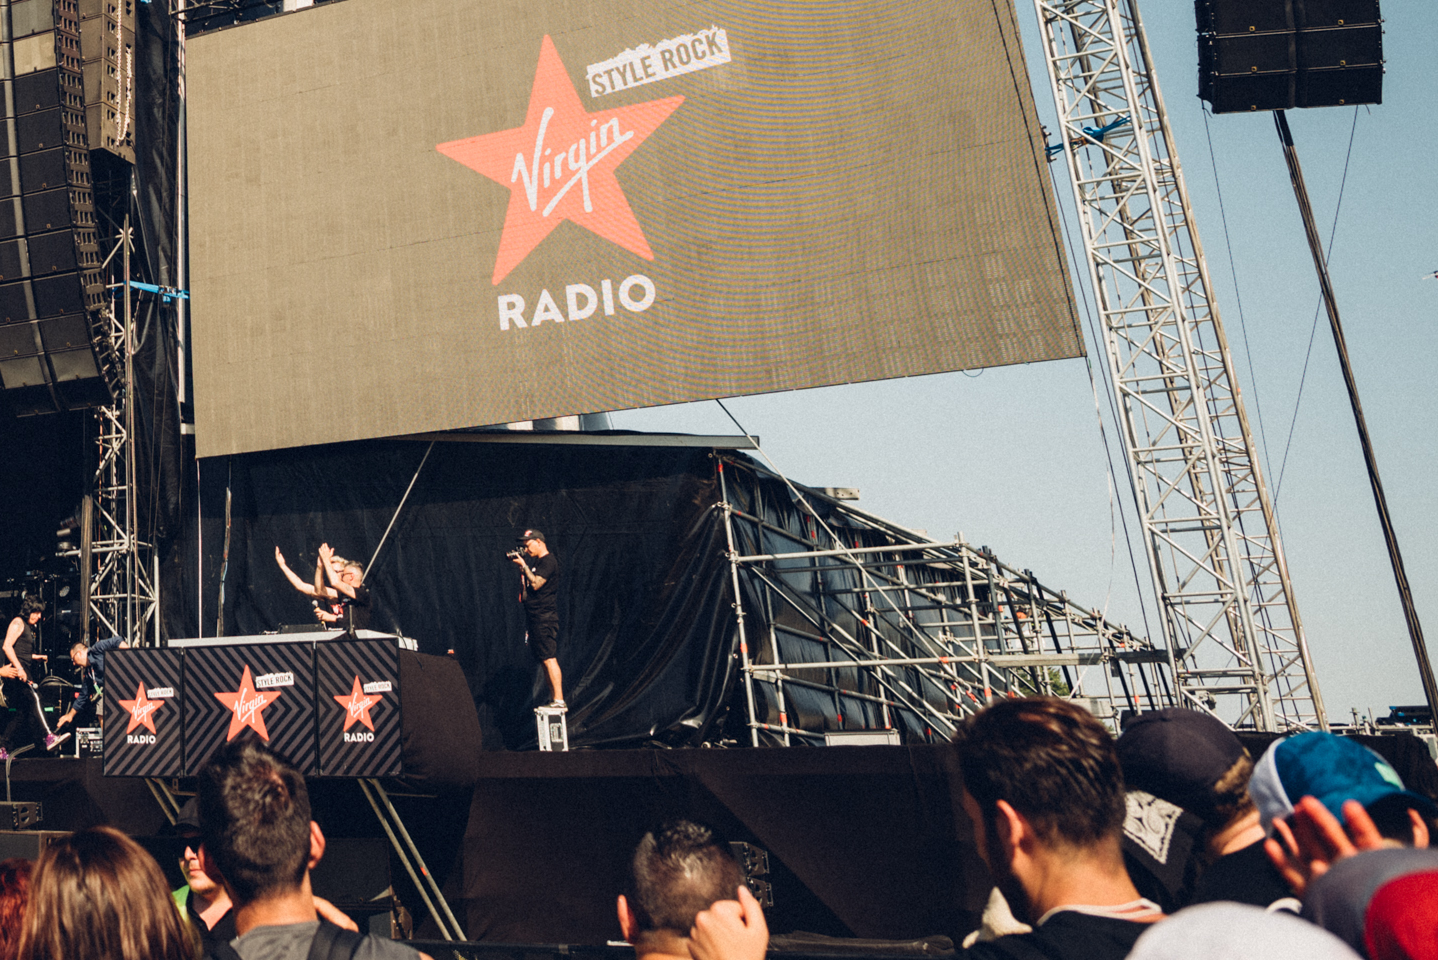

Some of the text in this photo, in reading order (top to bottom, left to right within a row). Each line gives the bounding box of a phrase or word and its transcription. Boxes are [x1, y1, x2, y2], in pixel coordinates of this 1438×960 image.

[591, 31, 723, 96] STYLE ROCK
[511, 106, 634, 217] Virgin
[497, 274, 656, 331] RADIO
[257, 674, 292, 688] STYLE ROCK
[131, 697, 155, 722] Virgin
[234, 687, 268, 724] Virgin
[347, 692, 372, 719] Virgin
[127, 734, 156, 745] RADIO
[344, 732, 375, 743] RADIO
